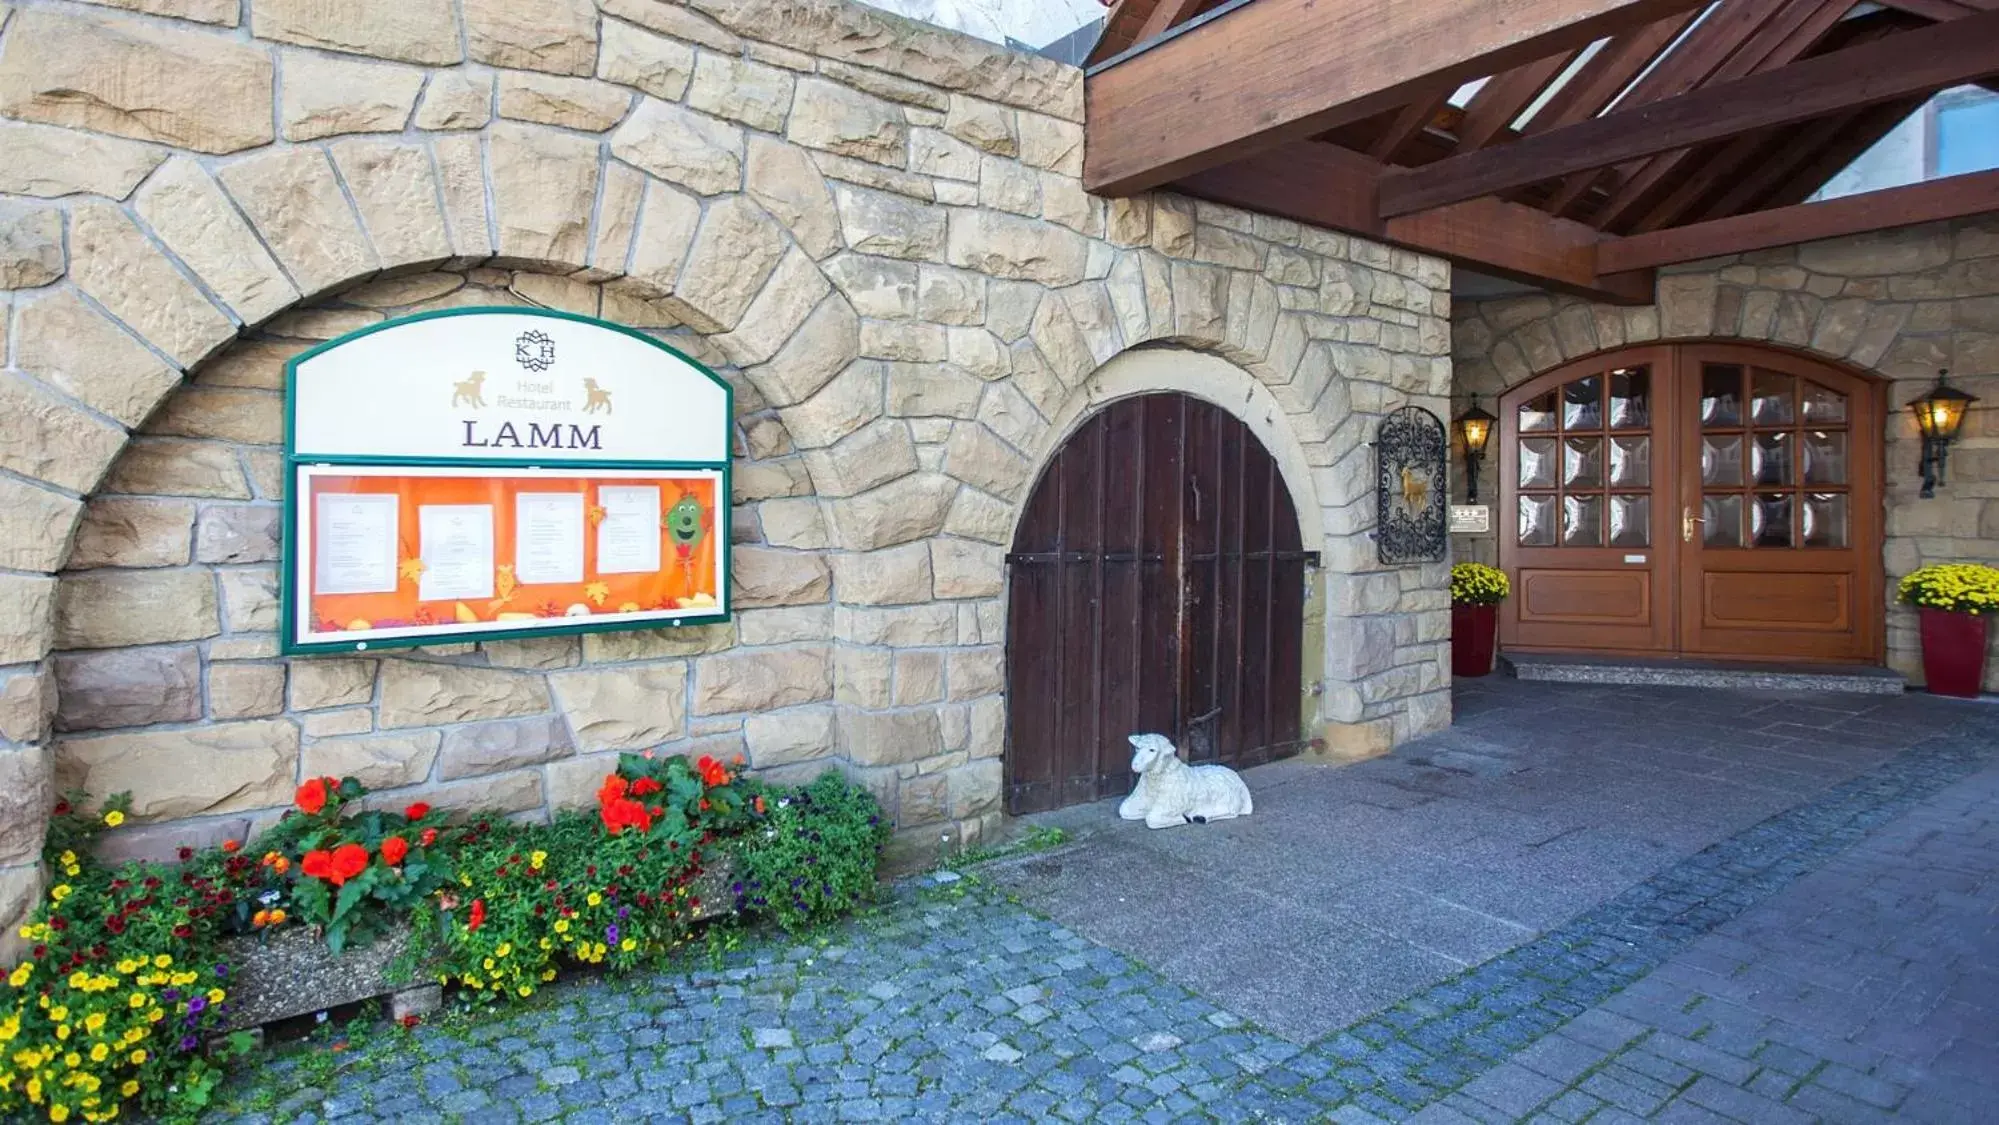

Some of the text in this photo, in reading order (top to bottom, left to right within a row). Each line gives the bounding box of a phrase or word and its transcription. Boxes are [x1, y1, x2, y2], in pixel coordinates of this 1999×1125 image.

[517, 381, 554, 394] Hotel
[496, 395, 572, 412] Restaurant
[462, 420, 603, 450] LAMM
